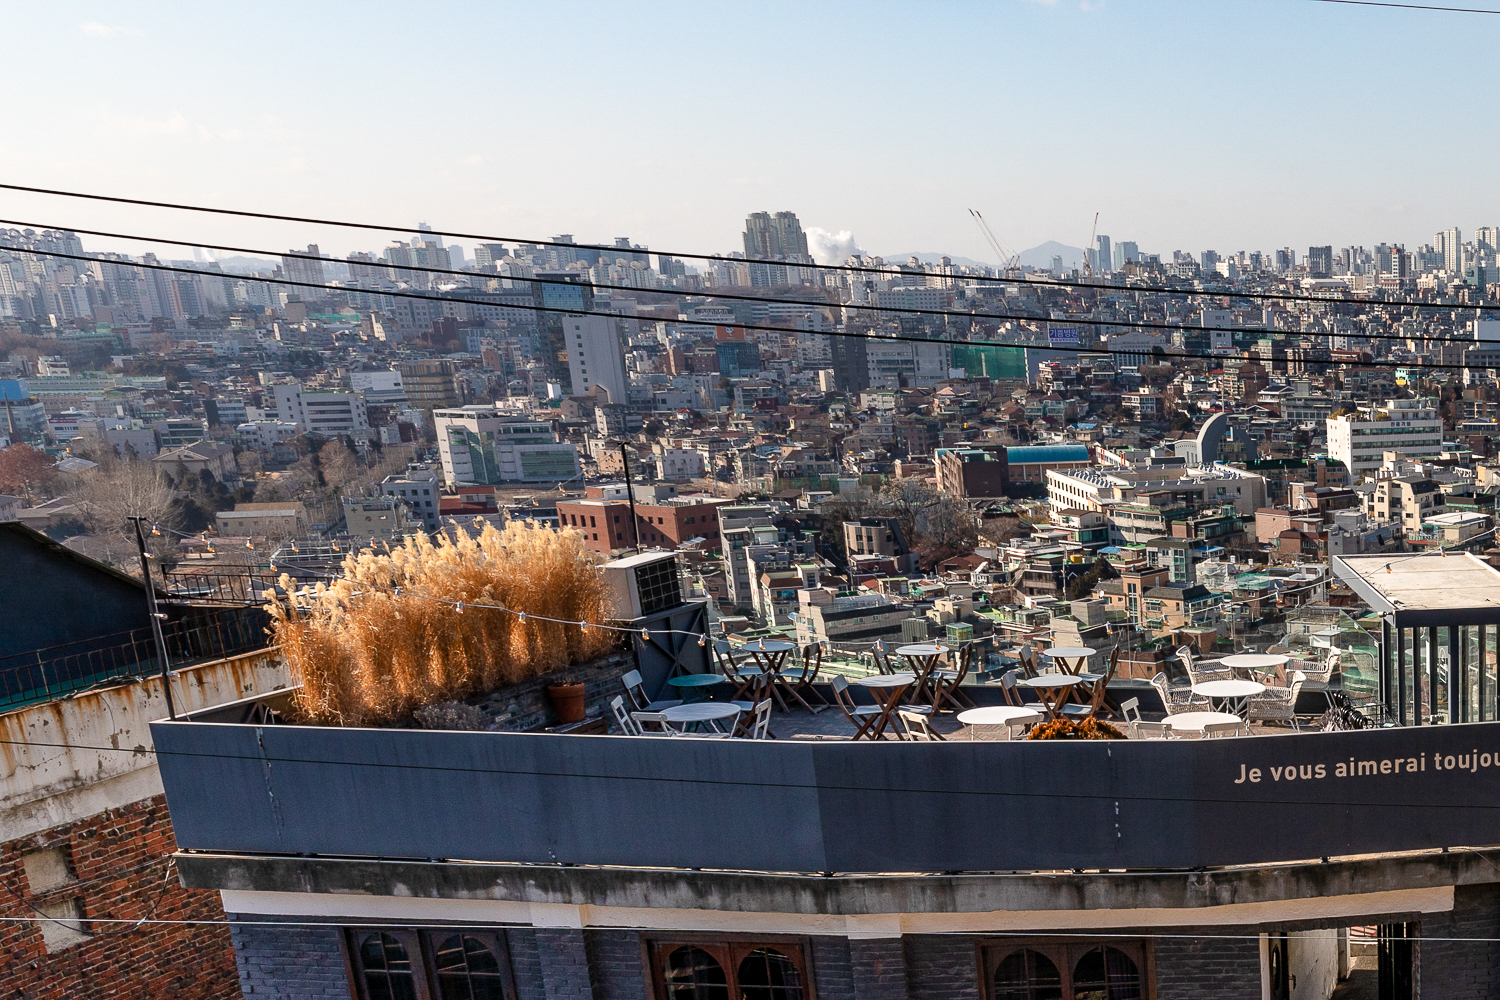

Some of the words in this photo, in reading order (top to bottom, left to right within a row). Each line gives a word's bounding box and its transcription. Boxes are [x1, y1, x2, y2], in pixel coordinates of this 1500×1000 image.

[1234, 763, 1262, 784] Je
[1270, 763, 1327, 781] vous
[1335, 752, 1426, 777] aimerai
